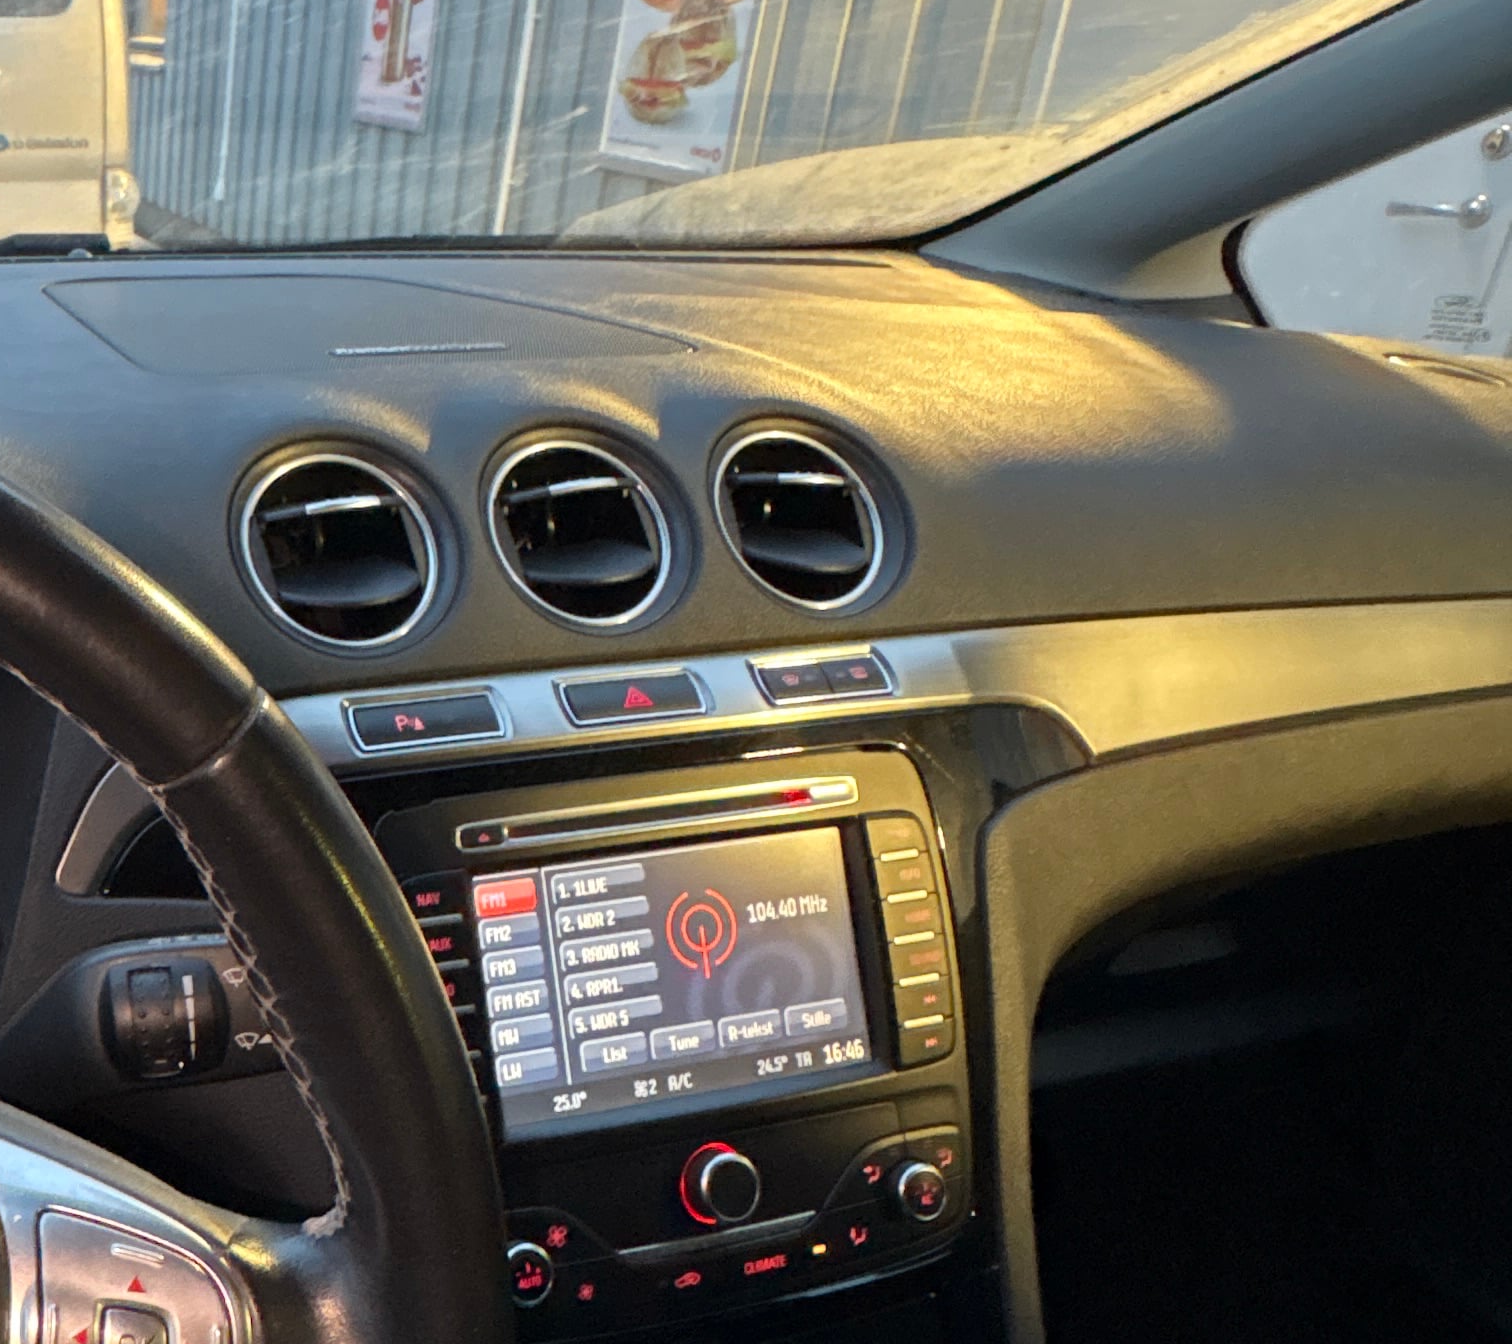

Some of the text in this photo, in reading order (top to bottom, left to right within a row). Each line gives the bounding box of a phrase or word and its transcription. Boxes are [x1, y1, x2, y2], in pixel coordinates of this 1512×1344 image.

[558, 876, 608, 899] 1. 1LIVE
[415, 892, 441, 907] NAV
[481, 892, 507, 909] FM1
[747, 893, 828, 924] 104.40 MHz
[562, 909, 616, 932] 2. WDR 2
[485, 925, 512, 944] FM2
[567, 950, 579, 966] 3.
[582, 944, 620, 964] RADIO
[489, 959, 516, 977] FM3
[494, 989, 541, 1012] FM AST
[571, 983, 583, 1000] 4.
[575, 1009, 629, 1034] 5. WDR 5
[801, 1011, 832, 1029] Stille
[498, 1028, 520, 1046] MW
[727, 1021, 774, 1042] R-tekst
[668, 1034, 700, 1052] Tune
[823, 1038, 866, 1065] 16:46
[603, 1045, 628, 1064] List
[794, 1050, 814, 1069] TA
[502, 1063, 522, 1081] LW
[668, 1071, 693, 1092] A/C
[743, 1254, 788, 1276] CLIMATE
[518, 1275, 543, 1290] AUTO
